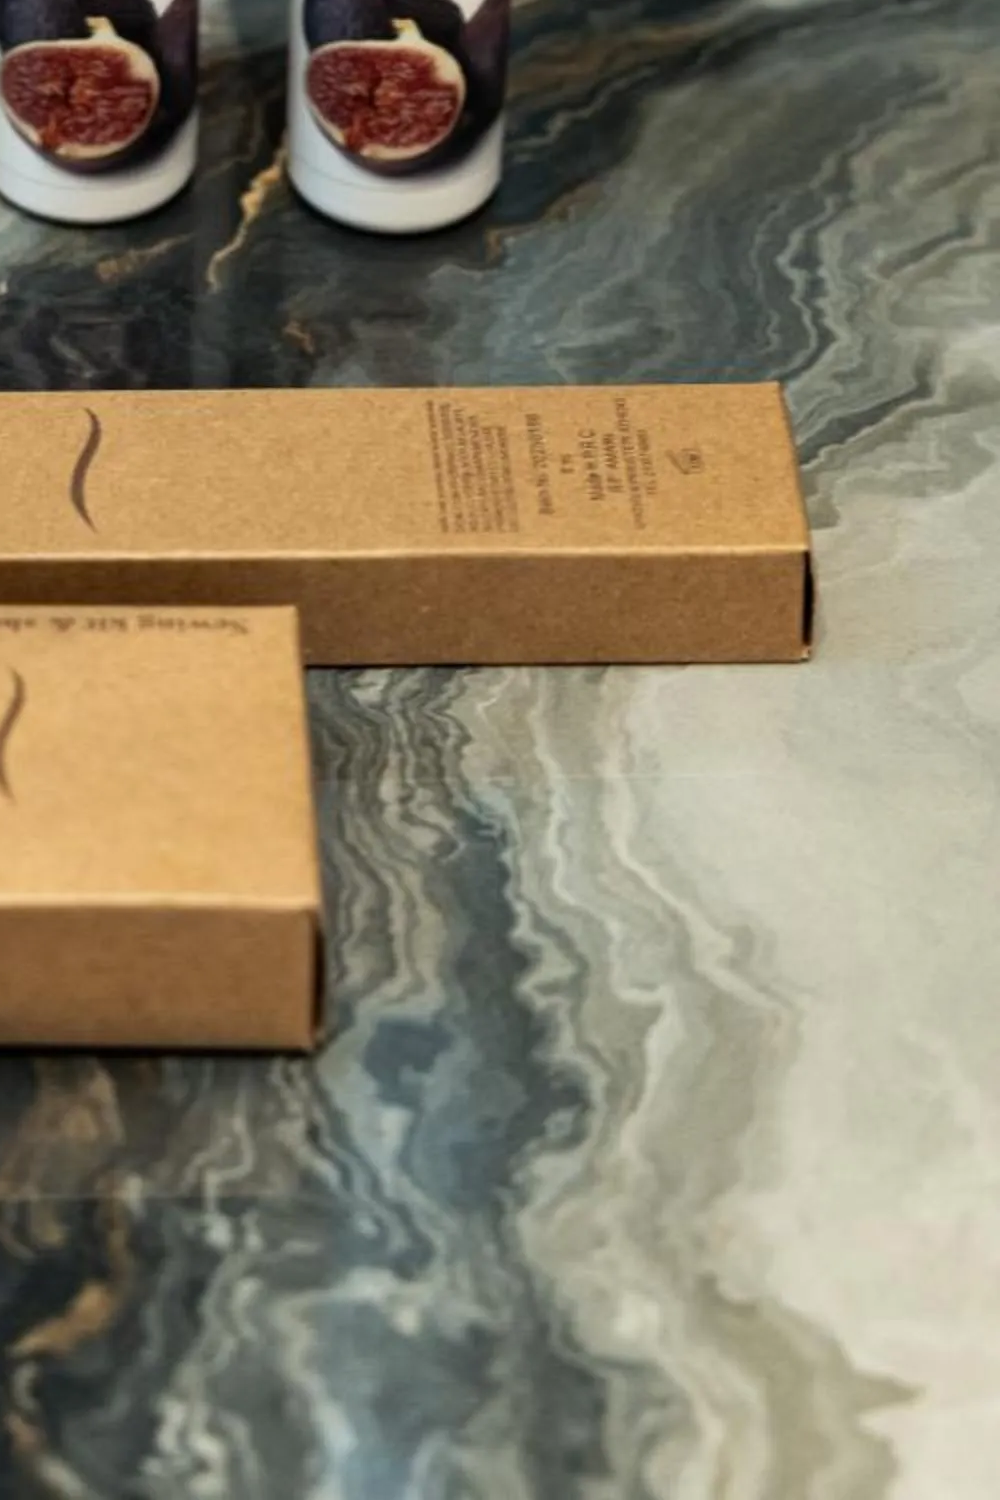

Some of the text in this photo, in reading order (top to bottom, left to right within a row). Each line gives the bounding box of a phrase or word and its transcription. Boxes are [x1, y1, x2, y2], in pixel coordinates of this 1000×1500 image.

[49, 615, 76, 632] &
[85, 615, 129, 632] kit
[137, 613, 249, 635] Sewing
